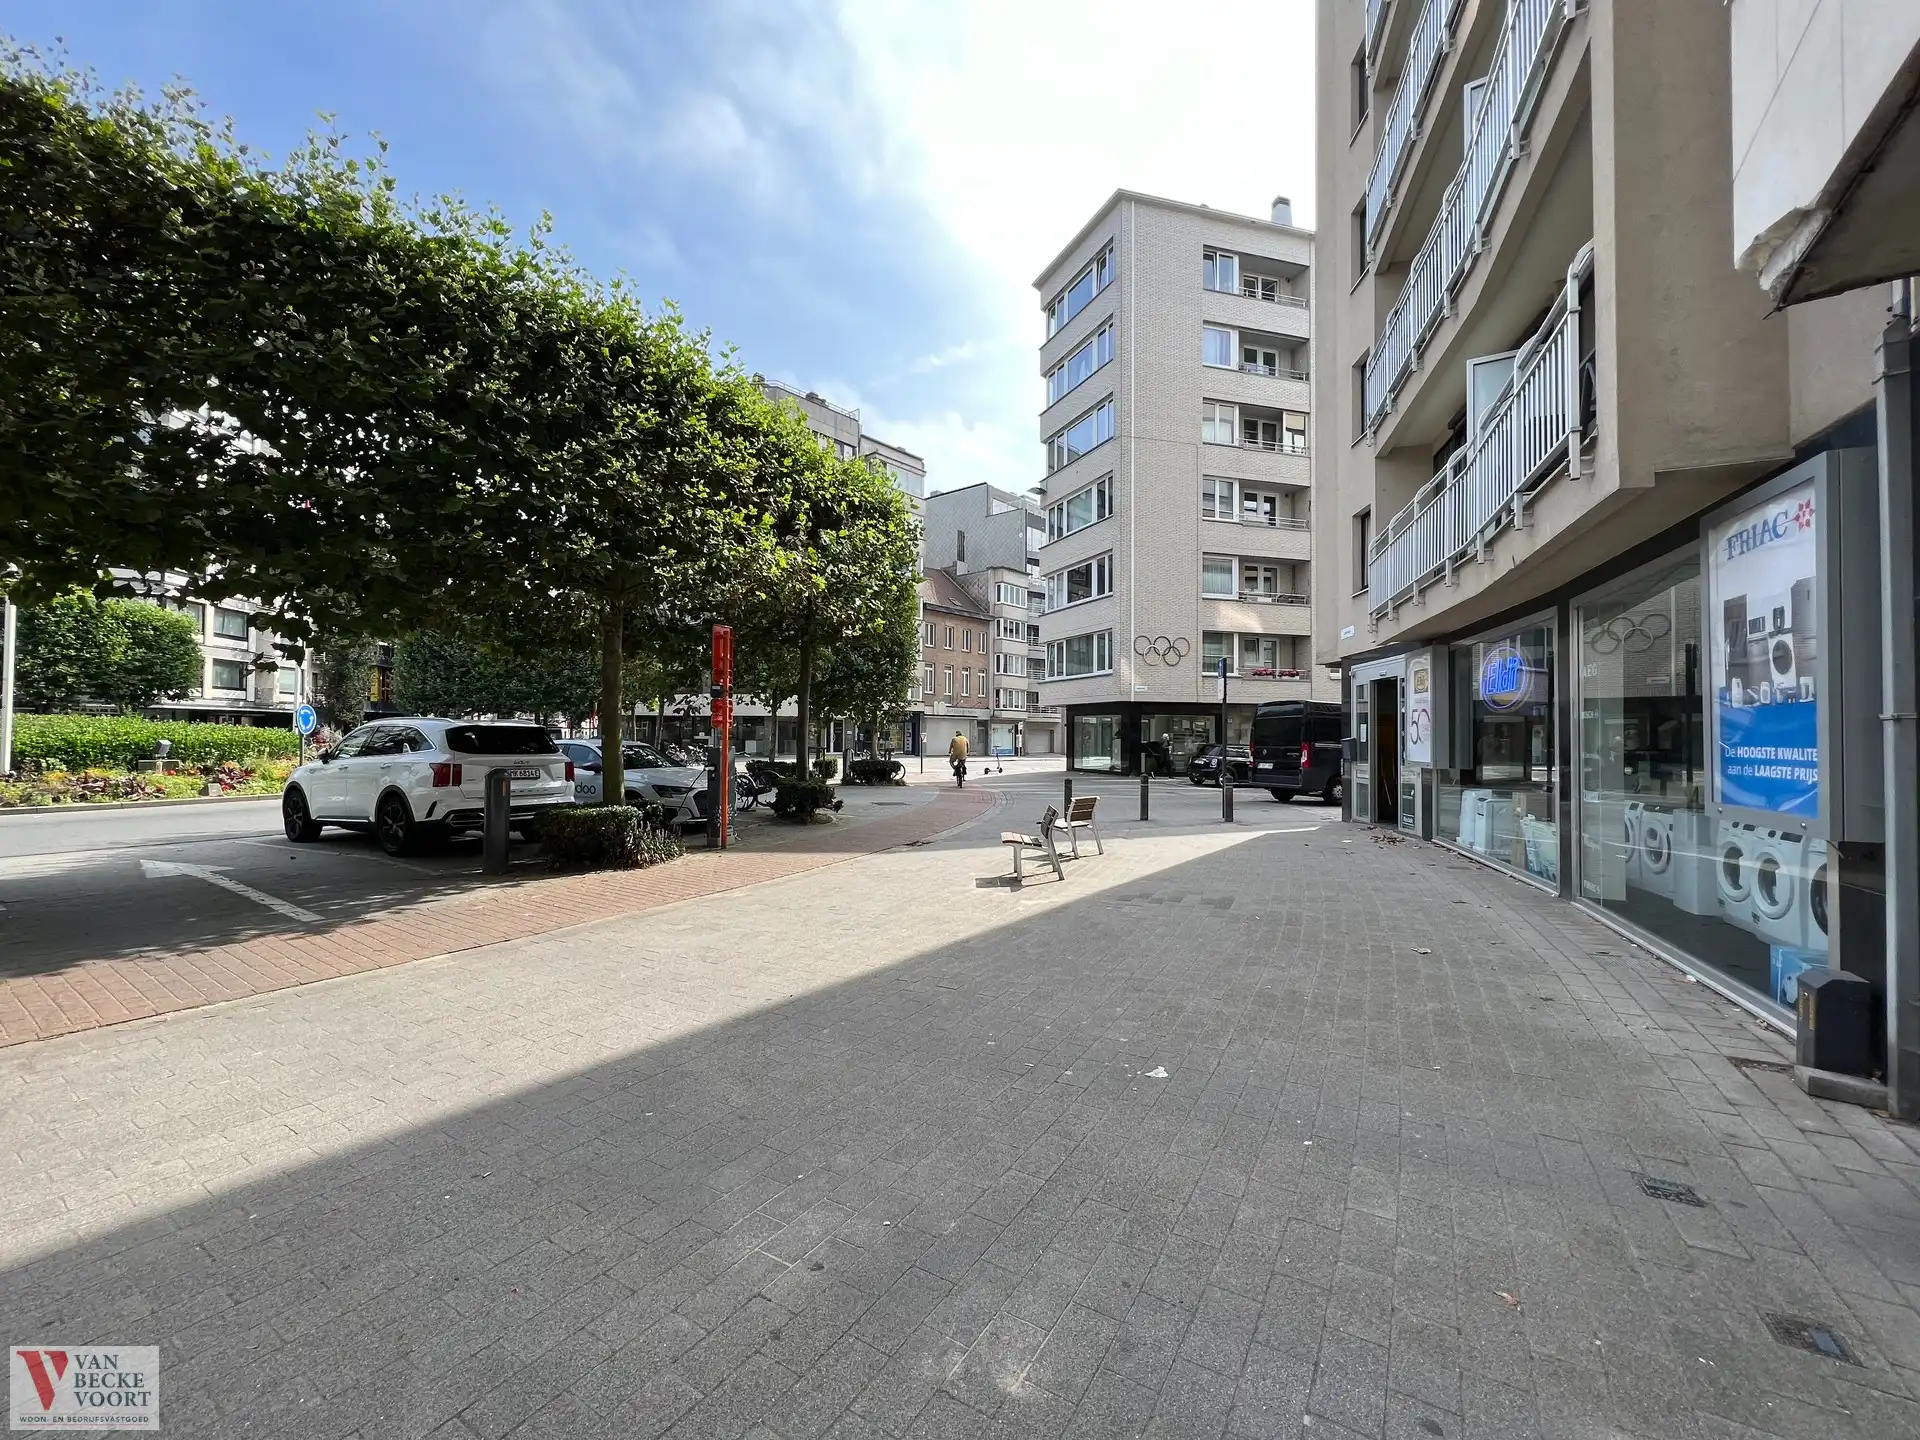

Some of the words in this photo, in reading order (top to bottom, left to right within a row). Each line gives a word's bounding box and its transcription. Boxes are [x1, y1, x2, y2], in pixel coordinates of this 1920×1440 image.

[1725, 510, 1788, 561] FRIAC
[1485, 656, 1519, 695] Eldi
[1724, 747, 1736, 757] De
[1737, 746, 1776, 760] HOOGSTE
[1727, 765, 1742, 775] aan
[1743, 764, 1754, 776] de
[1754, 765, 1792, 780] LAAGSTE
[1793, 767, 1818, 785] PRIJS
